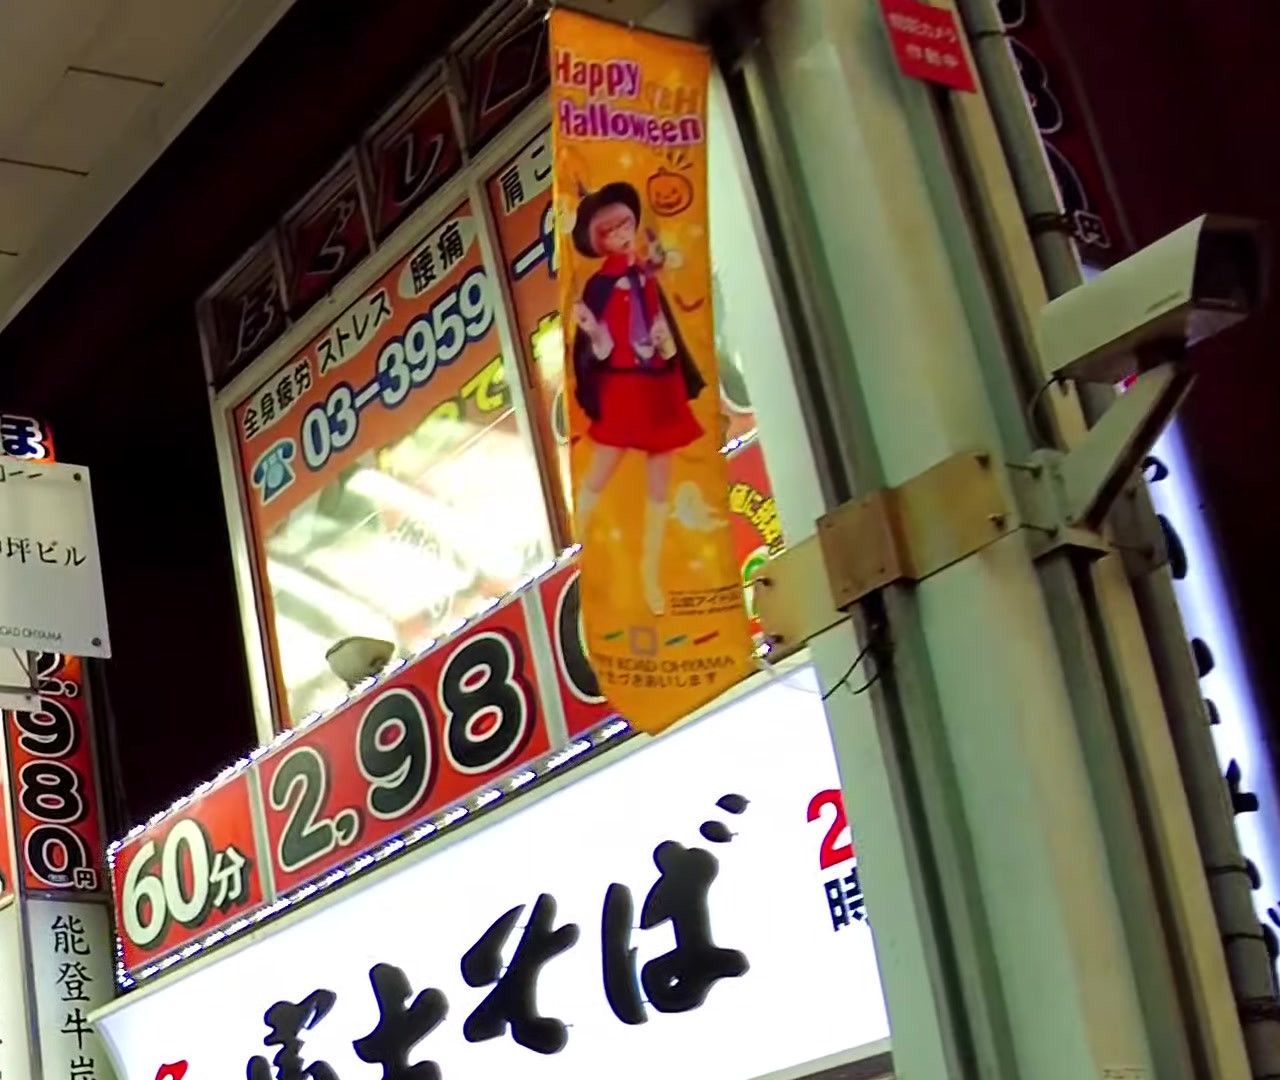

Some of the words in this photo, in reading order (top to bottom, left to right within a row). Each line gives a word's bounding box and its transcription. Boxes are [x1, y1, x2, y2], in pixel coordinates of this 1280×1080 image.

[554, 52, 640, 97] Happy
[558, 100, 703, 147] Halloween
[318, 289, 392, 374] ストレス
[410, 222, 466, 296] 腰痛
[300, 268, 495, 473] 03-3959
[22, 627, 64, 641] OHYAMA
[122, 818, 249, 951] 60分
